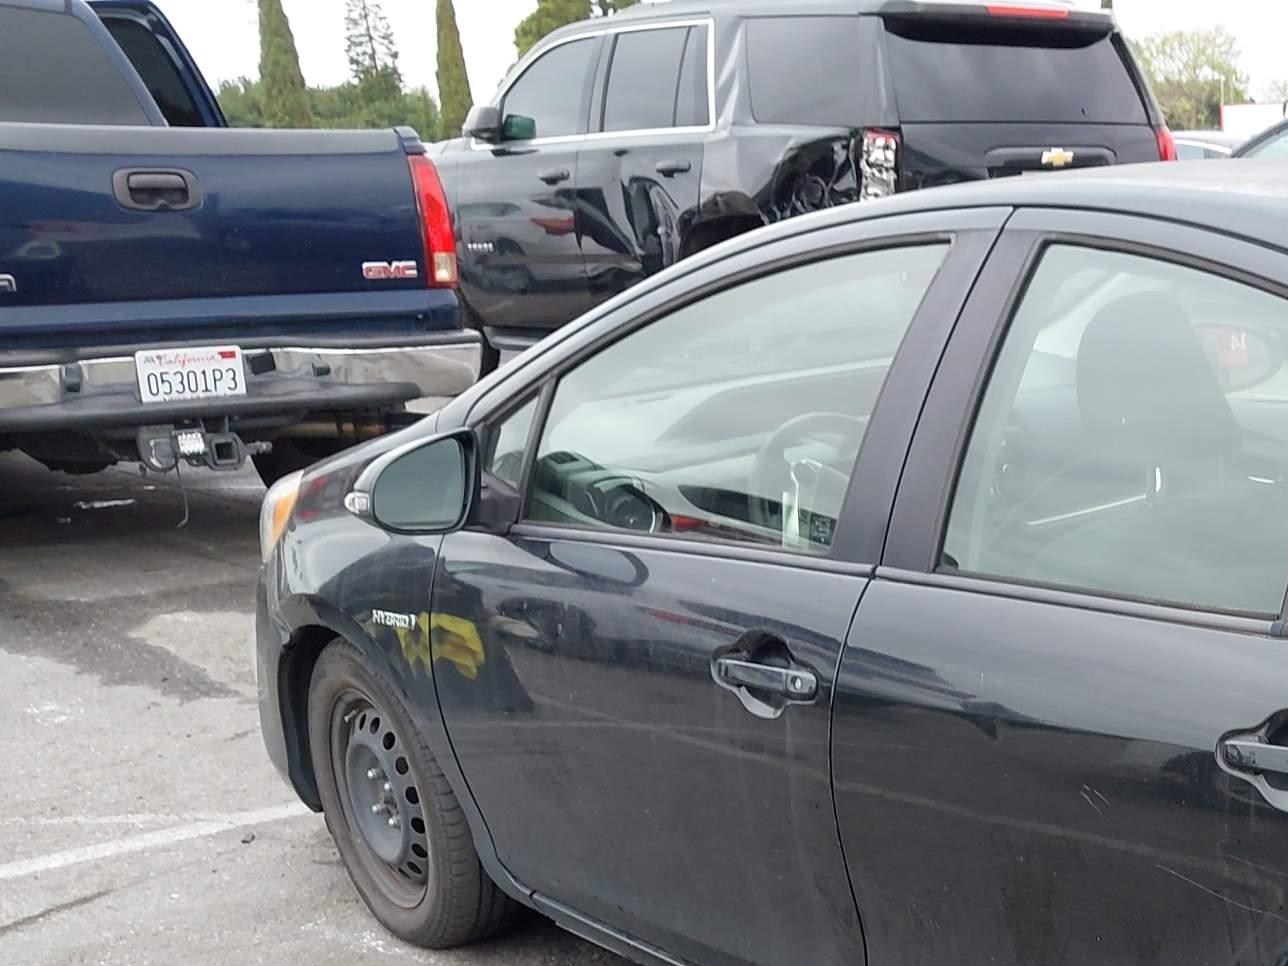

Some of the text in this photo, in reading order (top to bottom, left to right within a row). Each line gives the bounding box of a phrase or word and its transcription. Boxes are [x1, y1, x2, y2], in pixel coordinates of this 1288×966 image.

[362, 260, 418, 279] GMC
[147, 368, 237, 396] 05301P3
[372, 609, 409, 629] HYBRID
